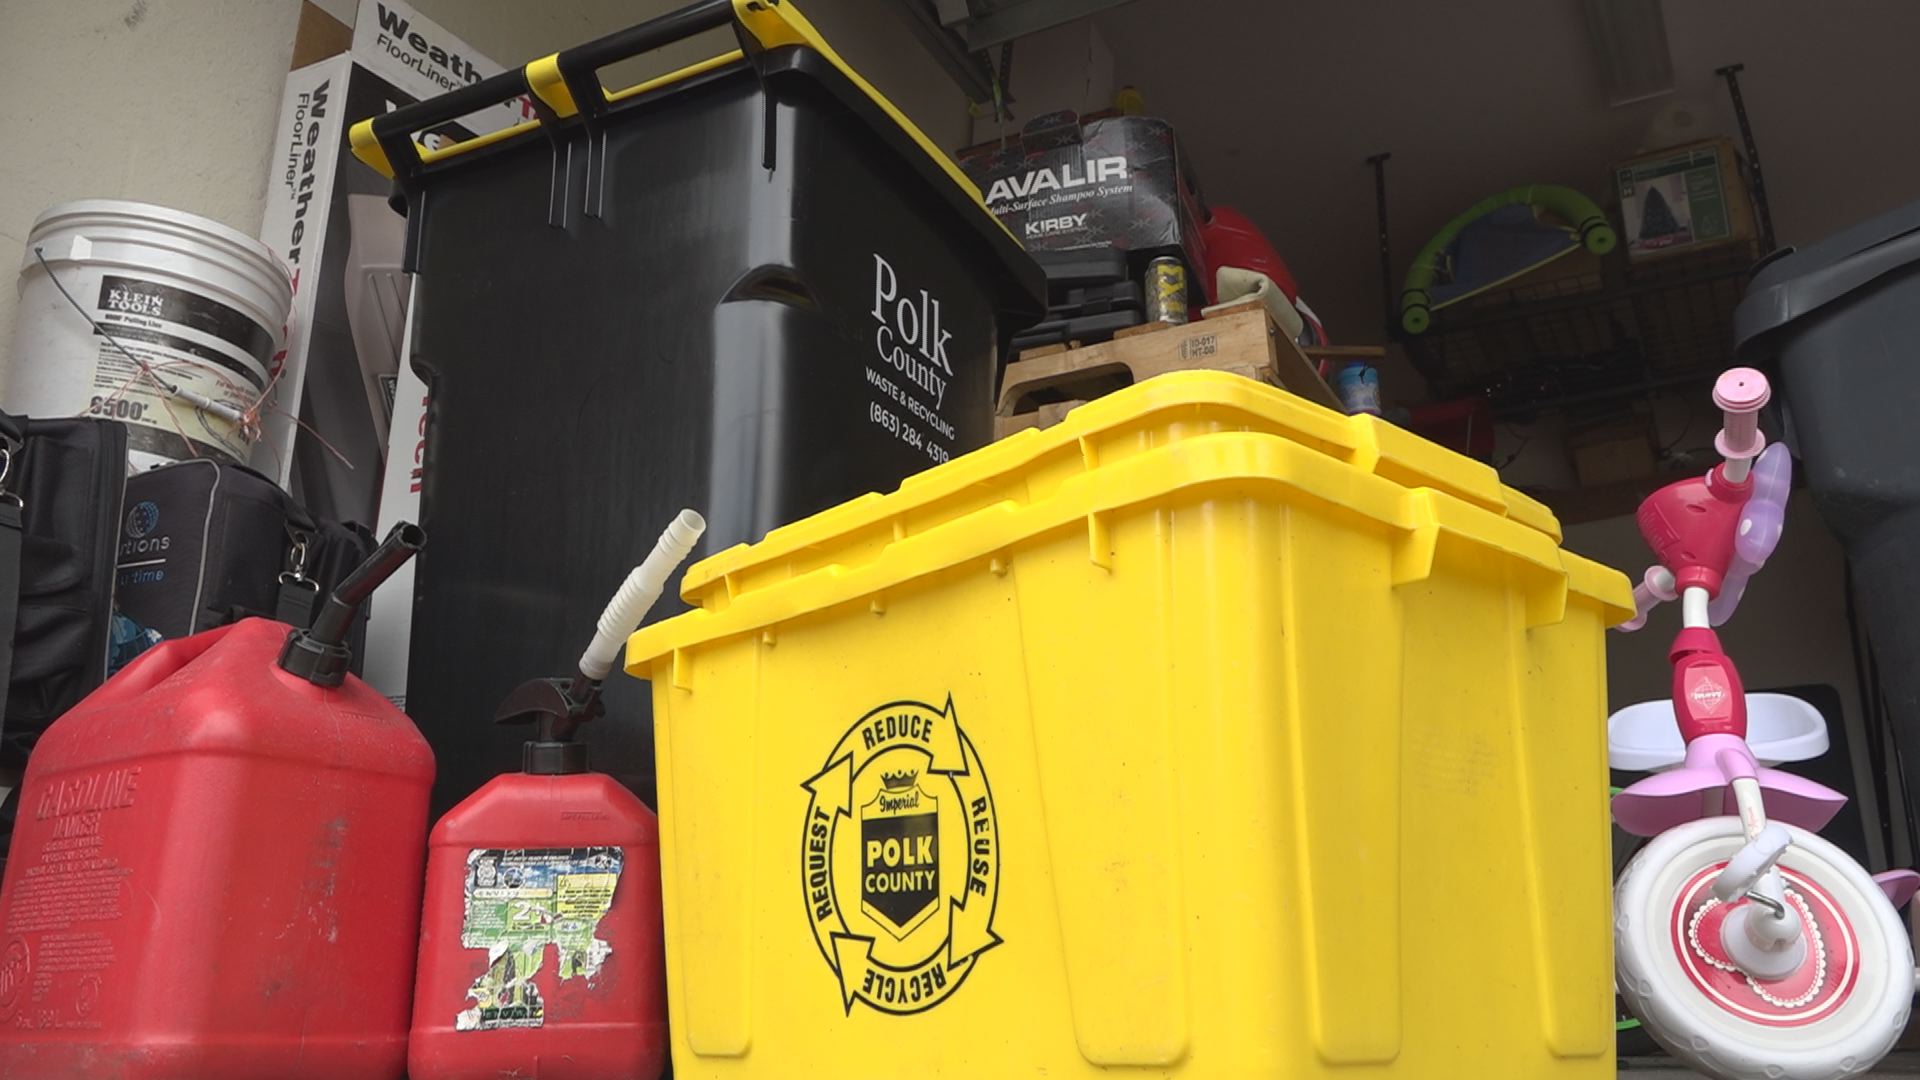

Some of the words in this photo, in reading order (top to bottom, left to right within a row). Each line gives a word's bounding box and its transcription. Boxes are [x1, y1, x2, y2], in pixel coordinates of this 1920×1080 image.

[985, 156, 1128, 205] AVALIR
[991, 197, 1047, 216] ulti-Surface
[1049, 188, 1095, 205] Shampoo
[1096, 184, 1133, 199] System
[1025, 213, 1088, 235] KIRBY
[108, 300, 162, 316] TOOLS
[109, 289, 164, 307] KLEIN
[871, 253, 954, 376] Polk
[876, 325, 947, 411] County
[865, 366, 899, 401] WASTE
[899, 390, 906, 407] &
[908, 396, 955, 440] RECYCLING
[869, 401, 900, 438] (863)
[902, 423, 922, 451] 284
[862, 714, 933, 750] REDUCE
[879, 790, 920, 814] Imperial
[808, 806, 834, 922] REQUEST
[866, 835, 934, 868] POLK
[969, 796, 990, 897] REUSE
[865, 870, 936, 893] COUNTY
[863, 963, 947, 1004] RECYCLE
